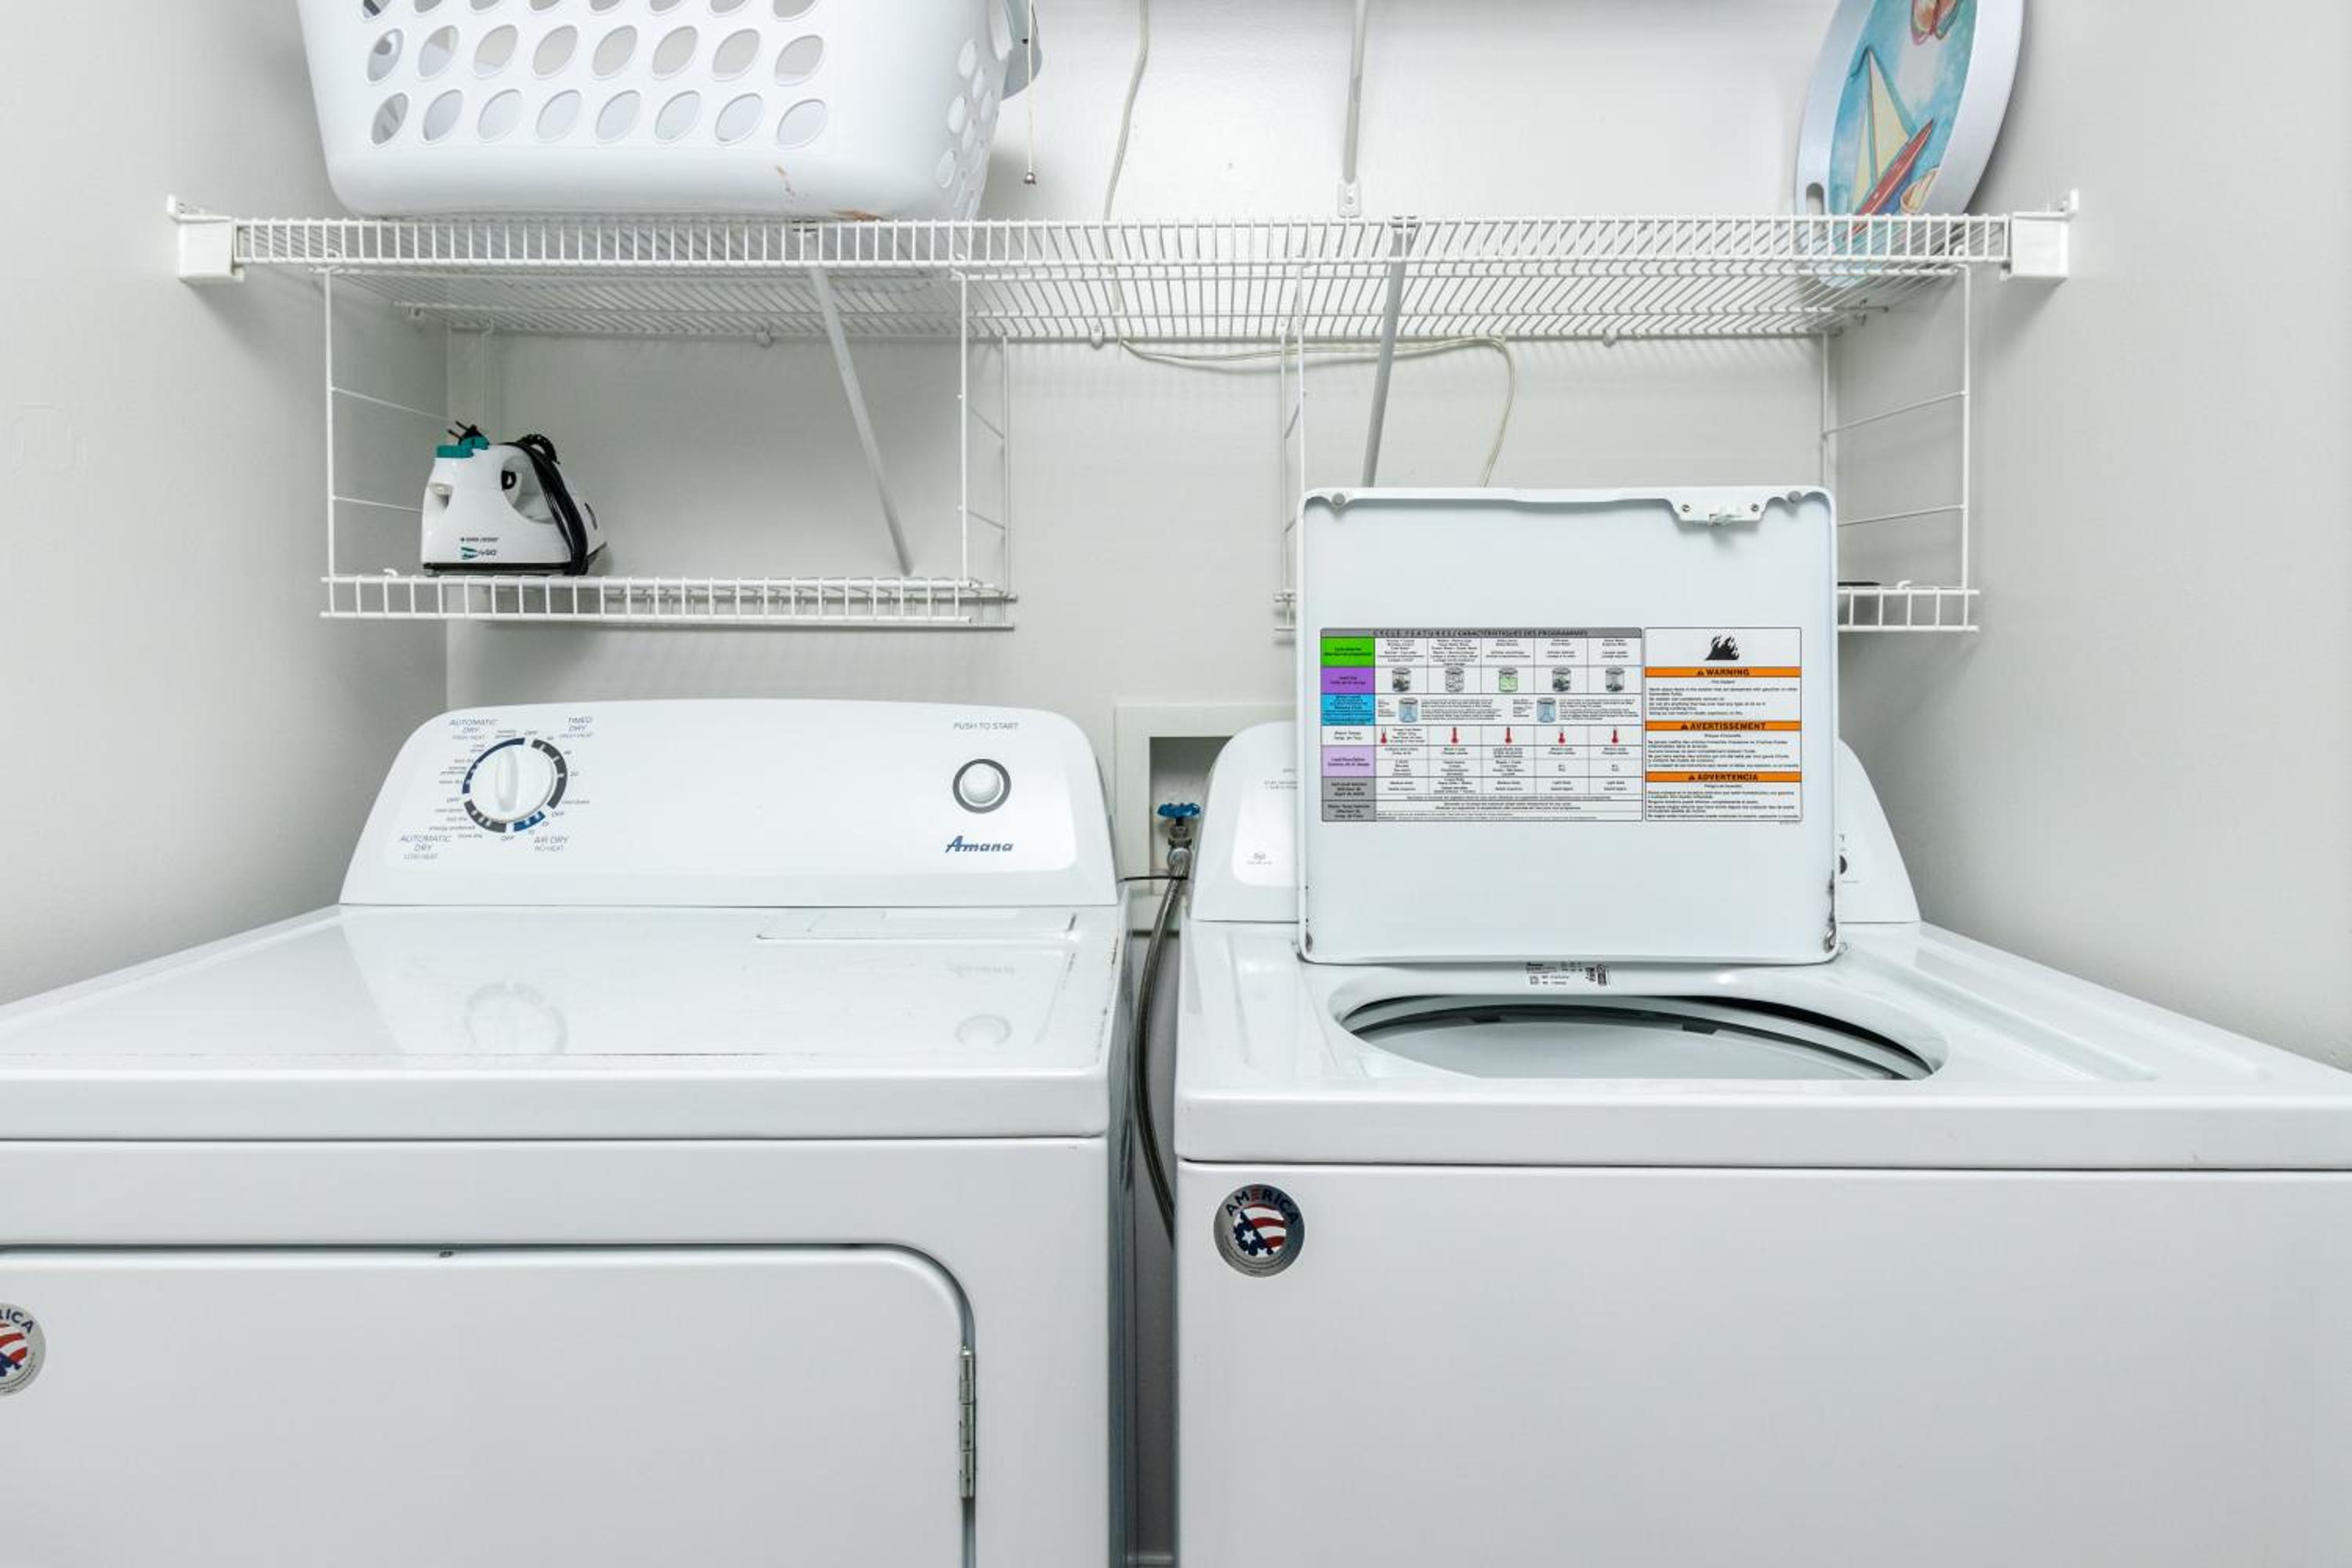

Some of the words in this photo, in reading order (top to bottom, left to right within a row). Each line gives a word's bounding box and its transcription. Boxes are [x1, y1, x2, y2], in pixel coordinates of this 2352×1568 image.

[953, 721, 978, 730] PUSH
[978, 721, 992, 730] TO
[993, 721, 1019, 730] START
[946, 835, 1014, 853] Amana
[1225, 1188, 1299, 1225] AMERICA
